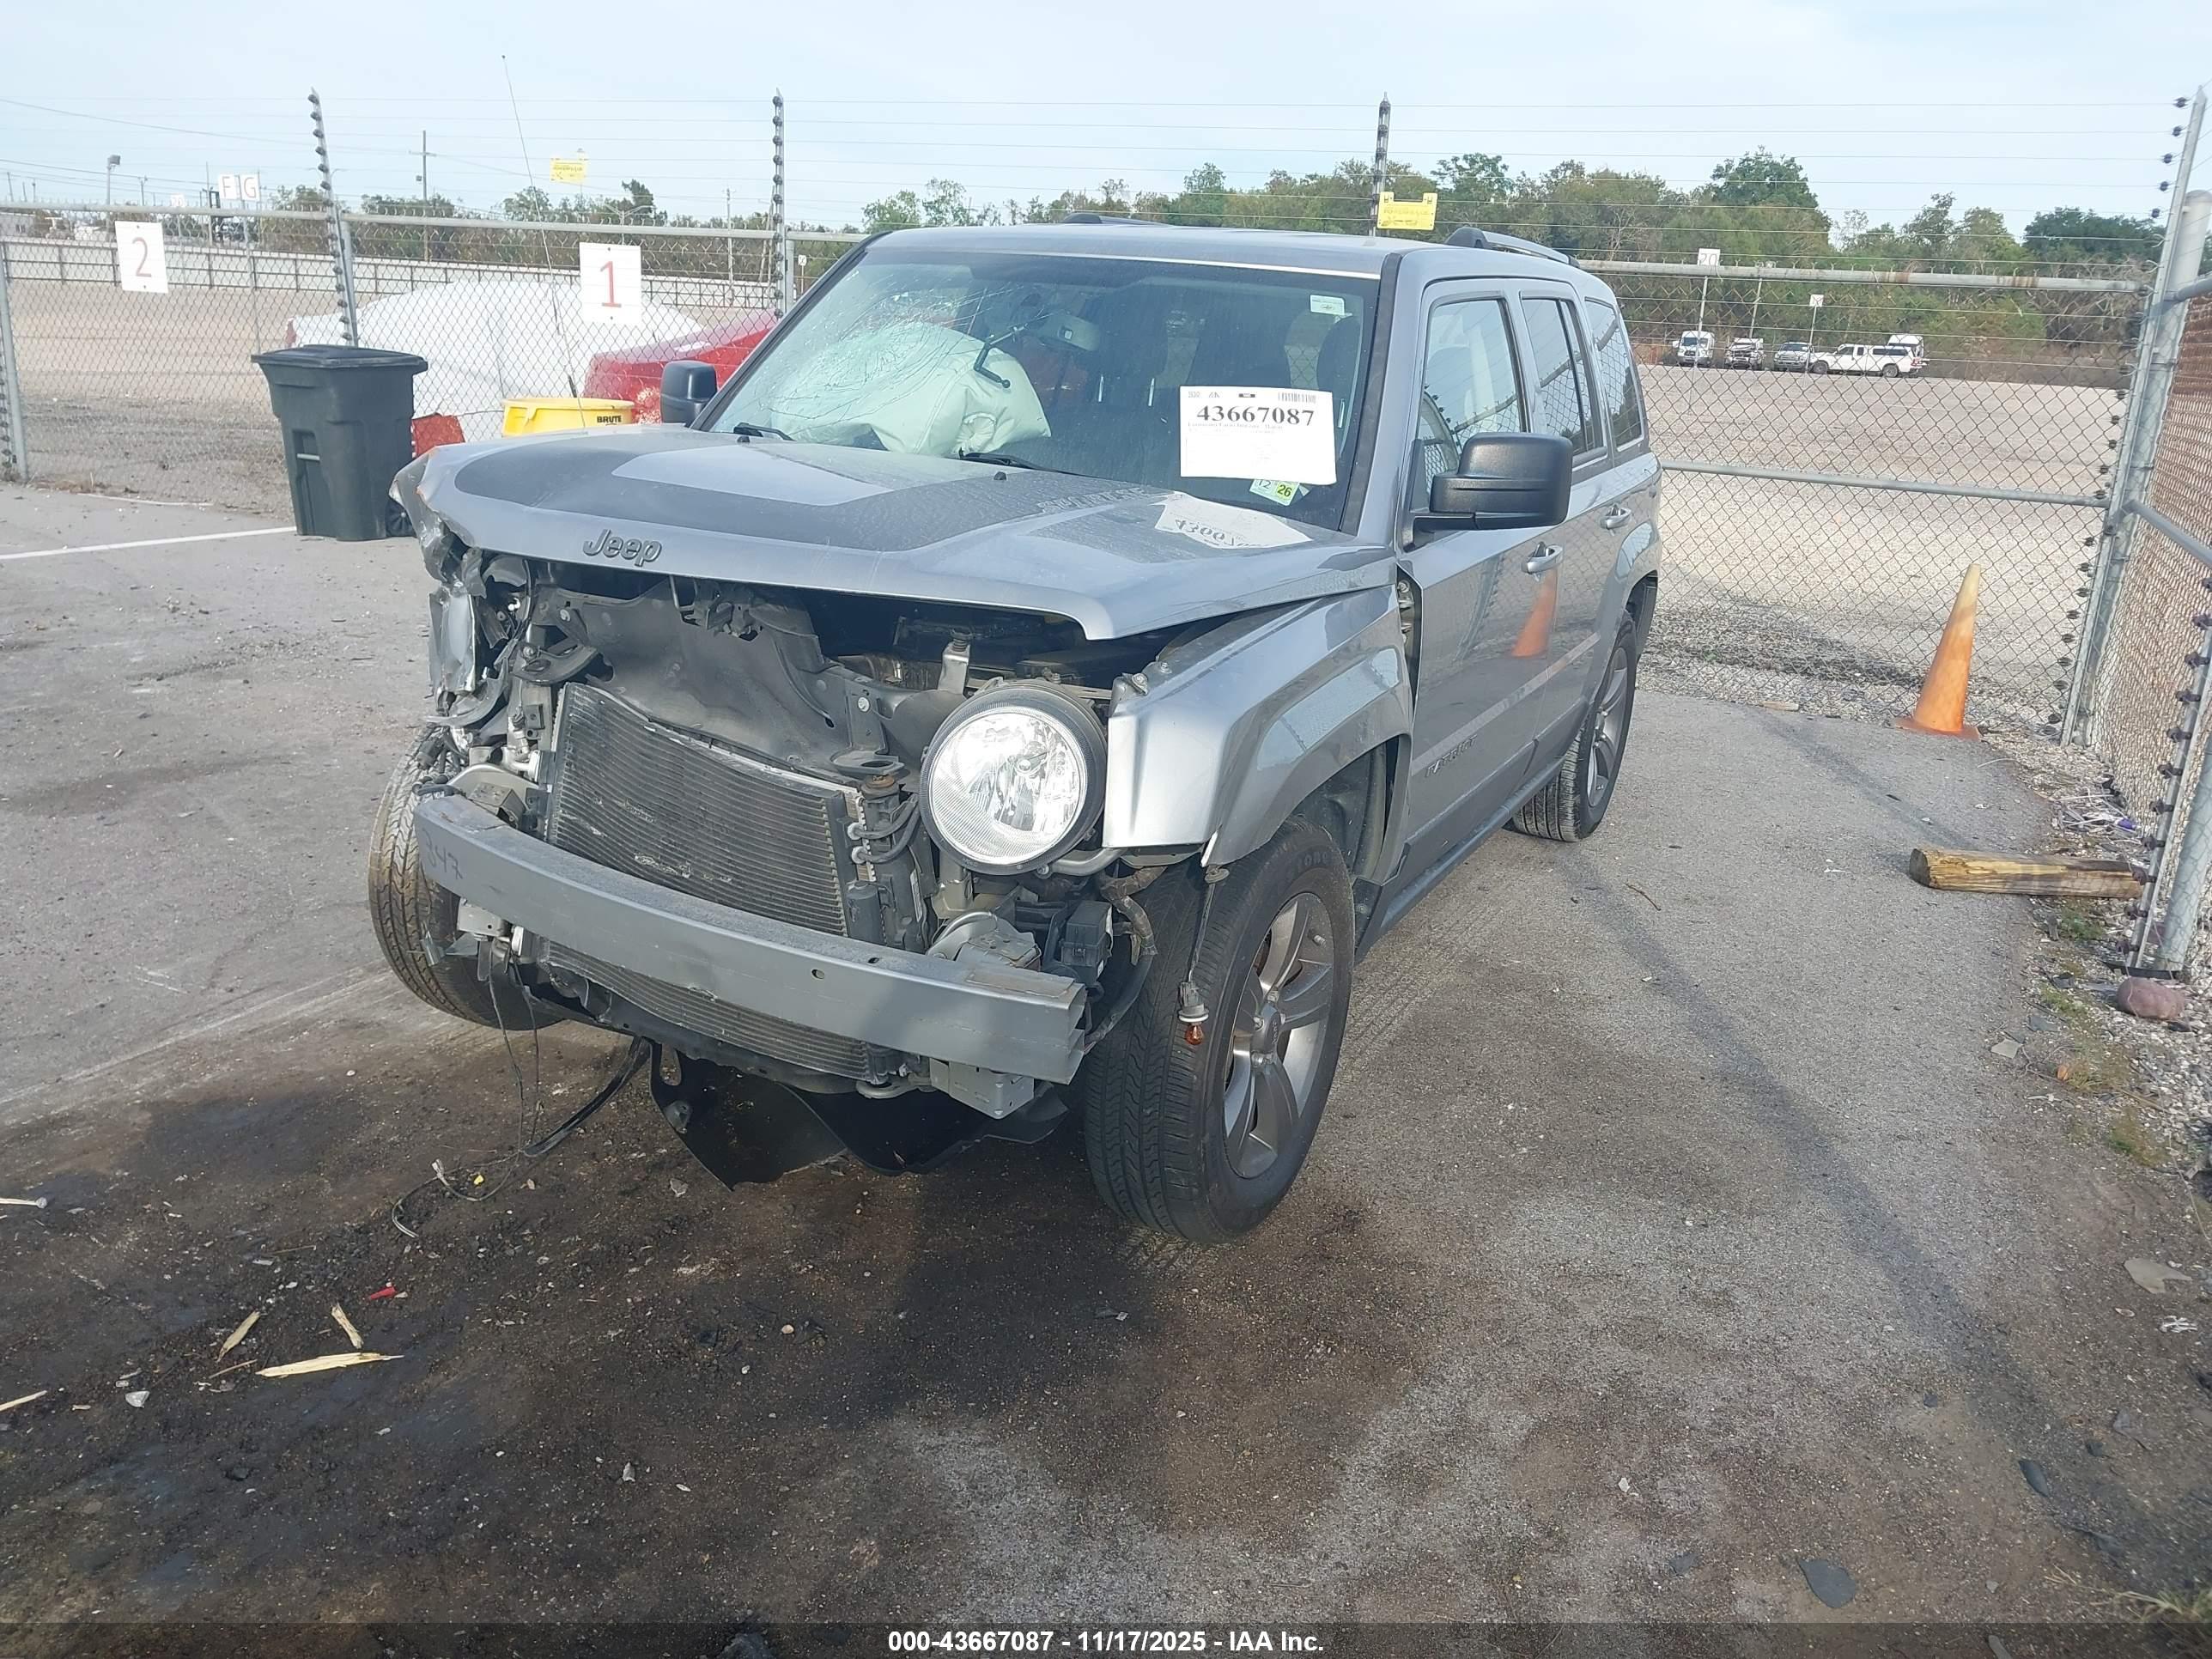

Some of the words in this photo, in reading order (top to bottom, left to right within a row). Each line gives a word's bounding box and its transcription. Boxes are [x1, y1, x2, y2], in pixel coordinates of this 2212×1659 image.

[222, 175, 232, 198] F
[244, 176, 257, 198] G
[131, 236, 152, 278] 2
[599, 260, 623, 308] 1
[596, 415, 622, 424] BRUTE
[1196, 404, 1315, 427] 43667087
[1277, 483, 1292, 497] 26
[583, 528, 662, 568] Jeep
